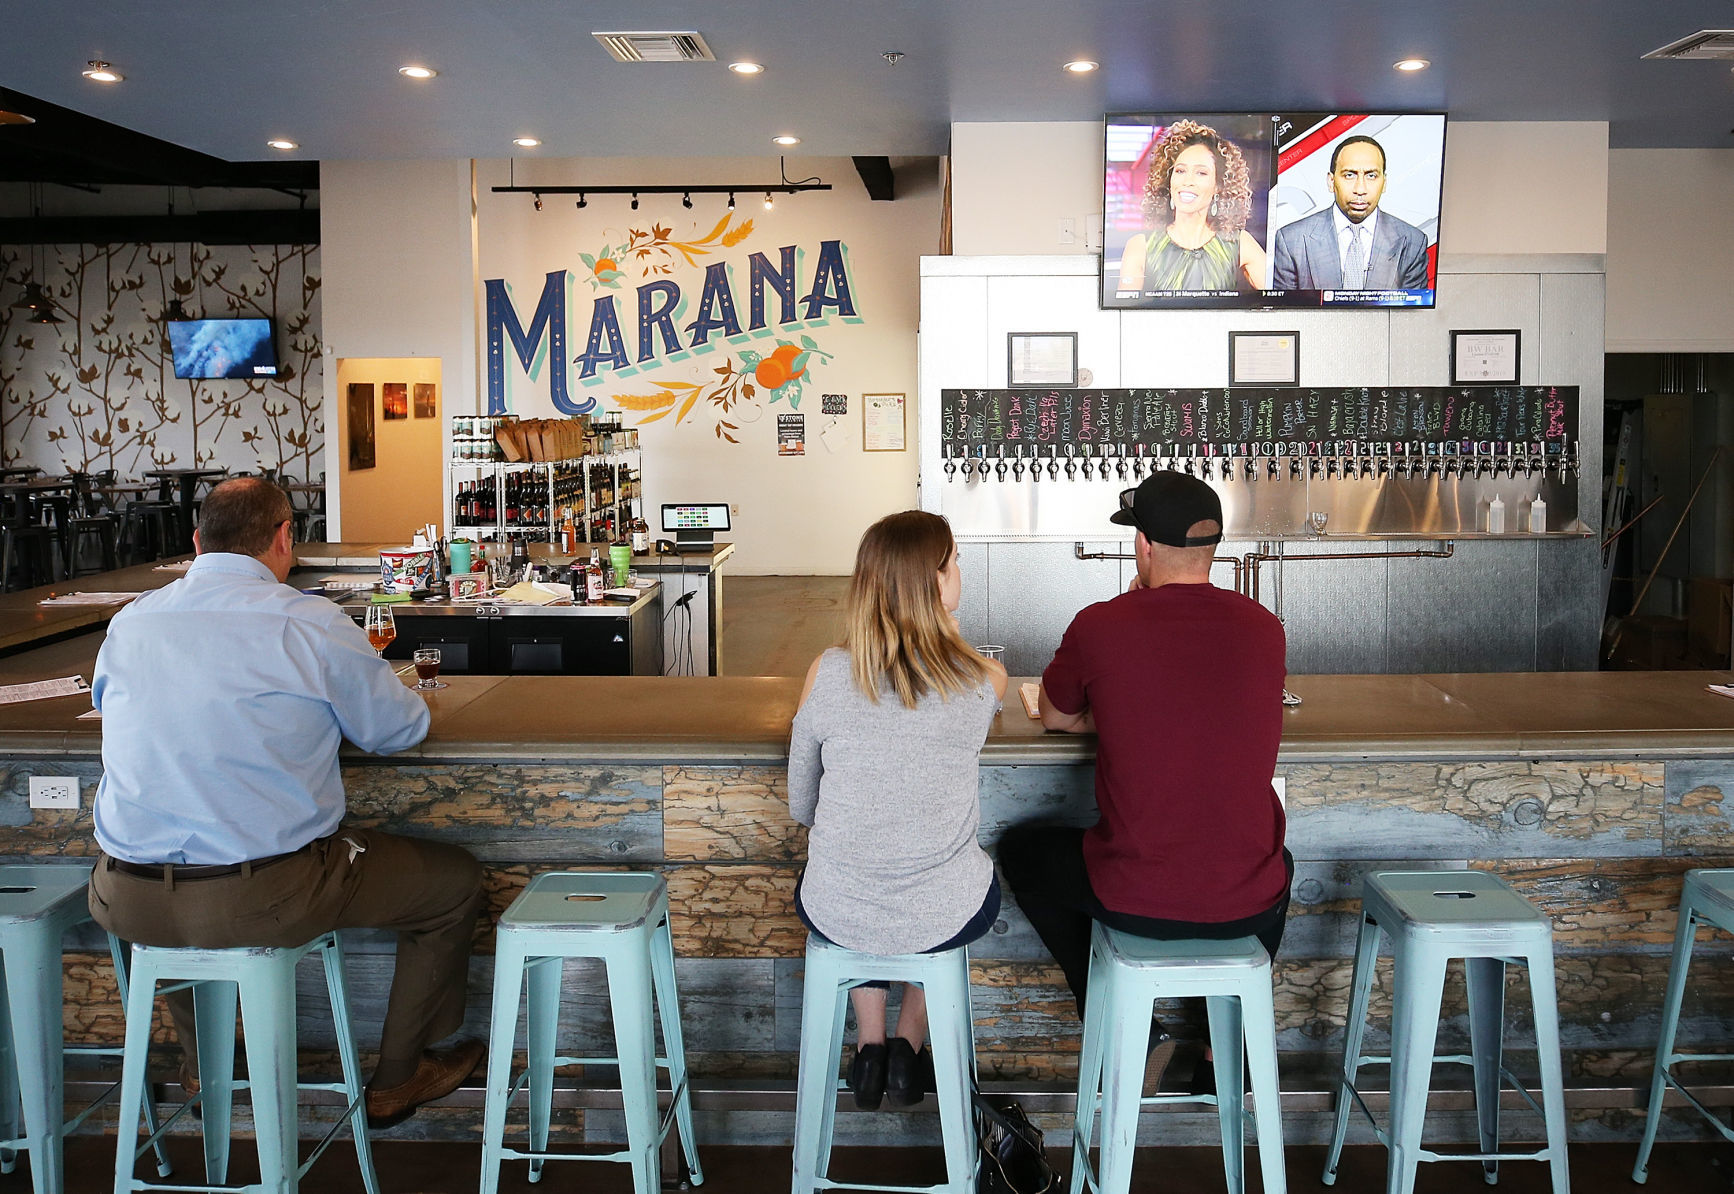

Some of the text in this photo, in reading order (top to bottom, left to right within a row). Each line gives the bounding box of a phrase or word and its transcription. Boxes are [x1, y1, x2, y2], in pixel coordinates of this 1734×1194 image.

[484, 240, 862, 416] MARANA
[1078, 395, 1098, 440] Dymaxion
[1114, 402, 1125, 437] Cerveza
[1306, 390, 1320, 418] HAZY
[1038, 412, 1050, 440] Czech
[1476, 405, 1484, 437] Catalina
